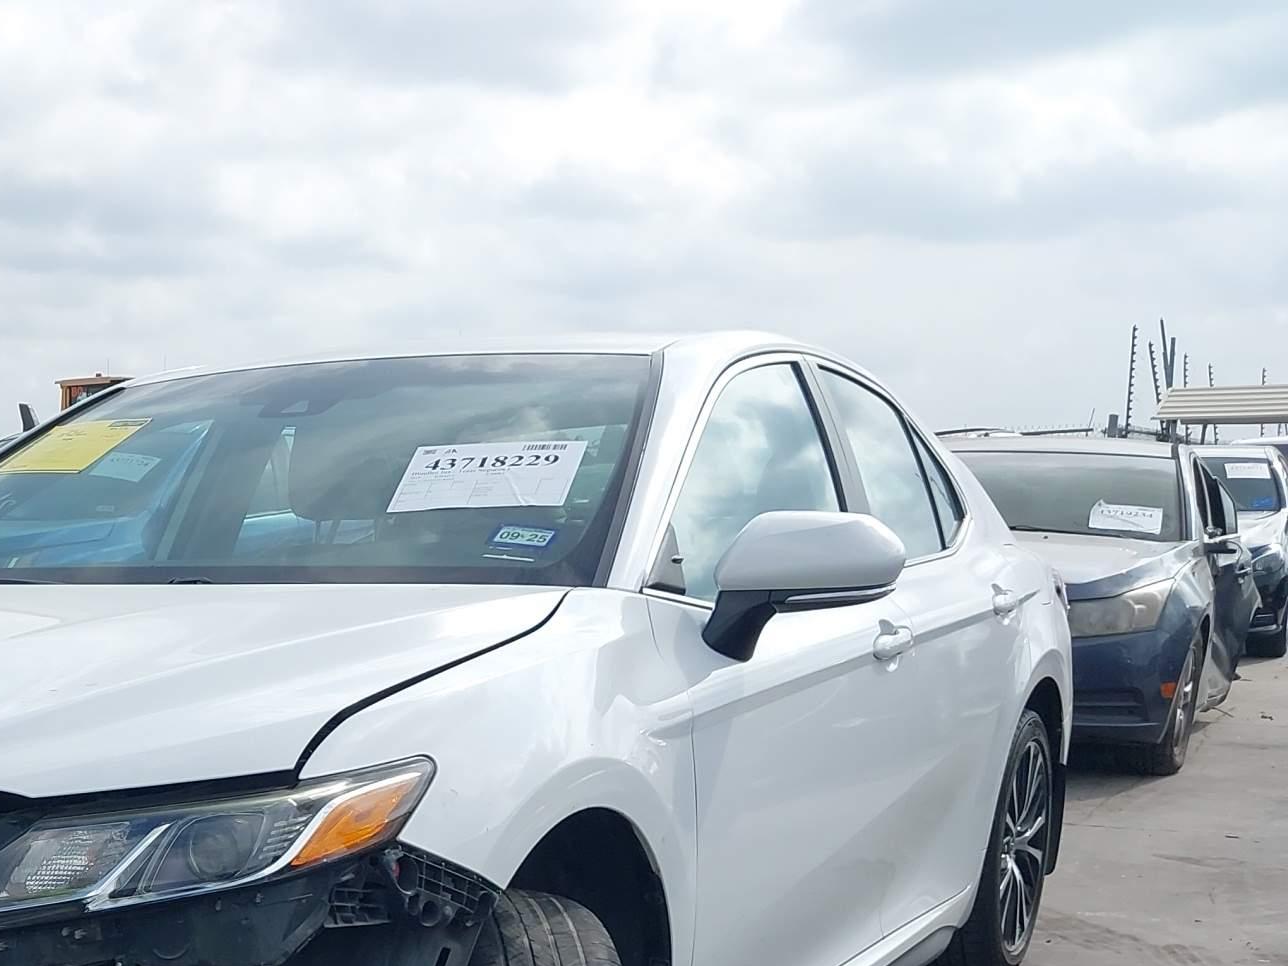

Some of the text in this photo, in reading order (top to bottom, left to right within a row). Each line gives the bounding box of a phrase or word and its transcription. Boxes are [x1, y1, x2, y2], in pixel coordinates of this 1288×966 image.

[424, 454, 560, 471] 43718229
[499, 531, 548, 543] 09 25
